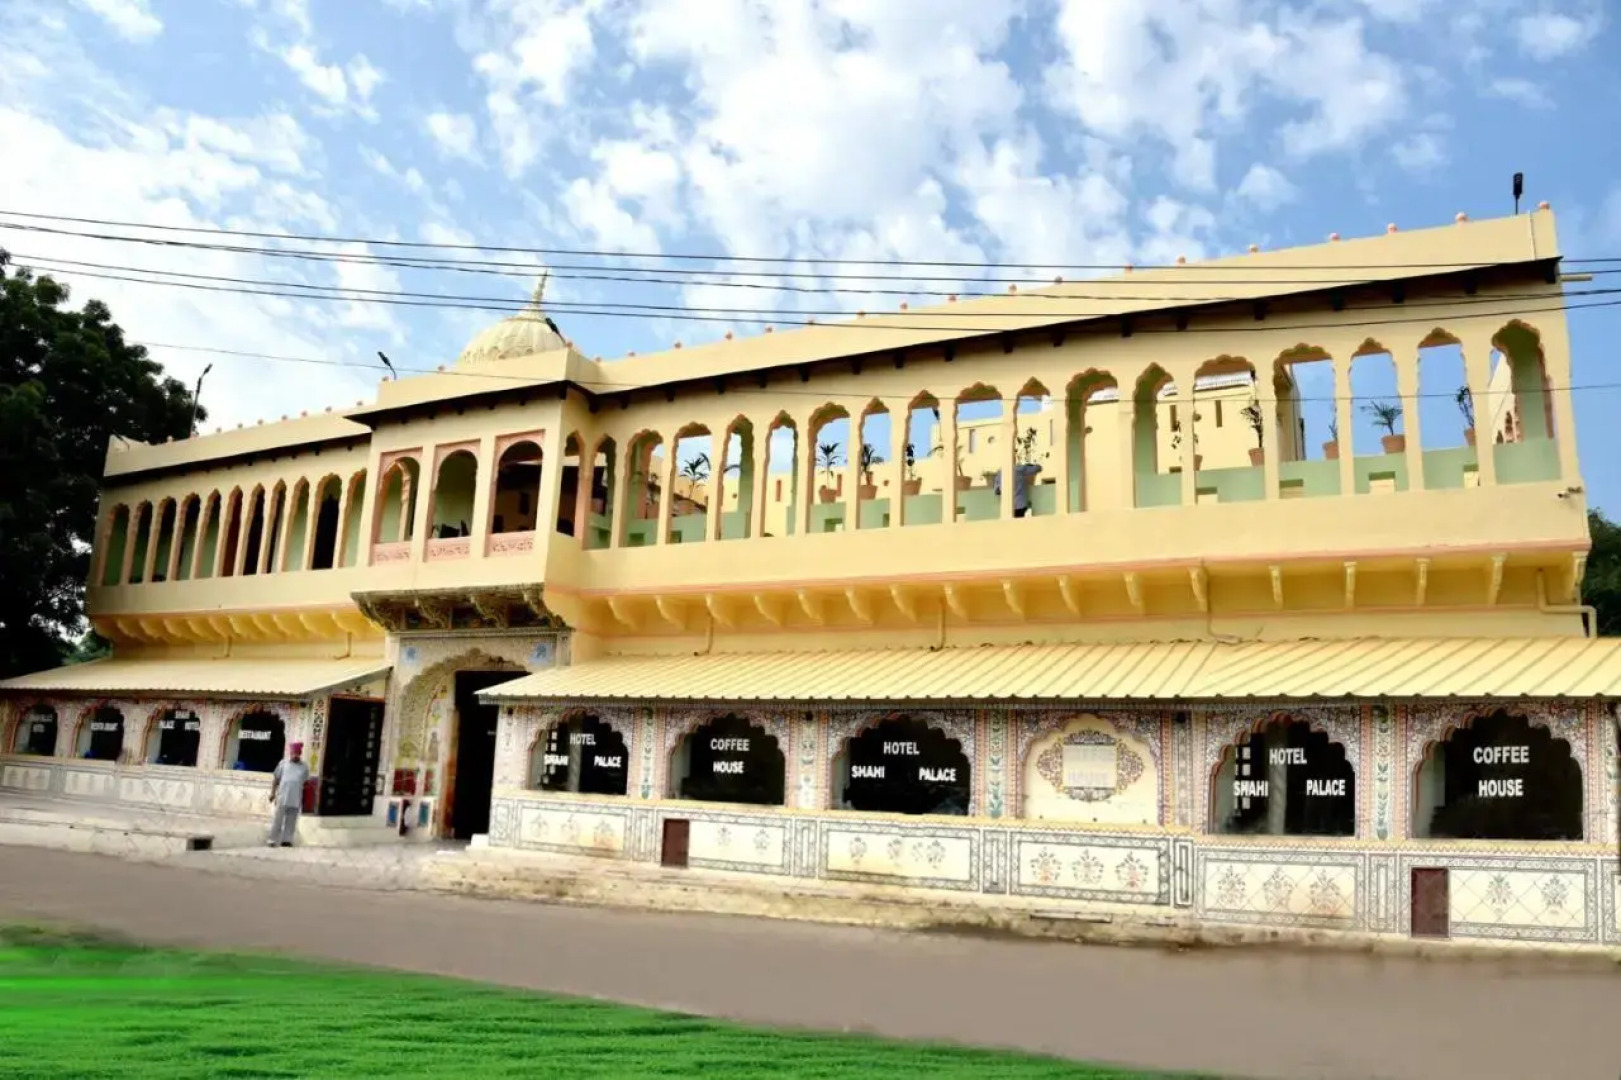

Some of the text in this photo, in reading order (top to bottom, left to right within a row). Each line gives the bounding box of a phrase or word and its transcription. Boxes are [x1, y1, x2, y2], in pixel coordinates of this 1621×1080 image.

[569, 733, 597, 746] HOTEL
[710, 738, 750, 752] COFFEE
[883, 741, 920, 755] HOTEL
[1473, 746, 1530, 764] COFFEE
[594, 755, 622, 768] PALACE
[1269, 747, 1308, 766] HOTEL
[712, 760, 744, 774] HOUSE
[851, 765, 957, 782] SHAHI PALACE
[1233, 779, 1346, 797] SHAHI PALACE
[1478, 778, 1524, 797] HOUSE
